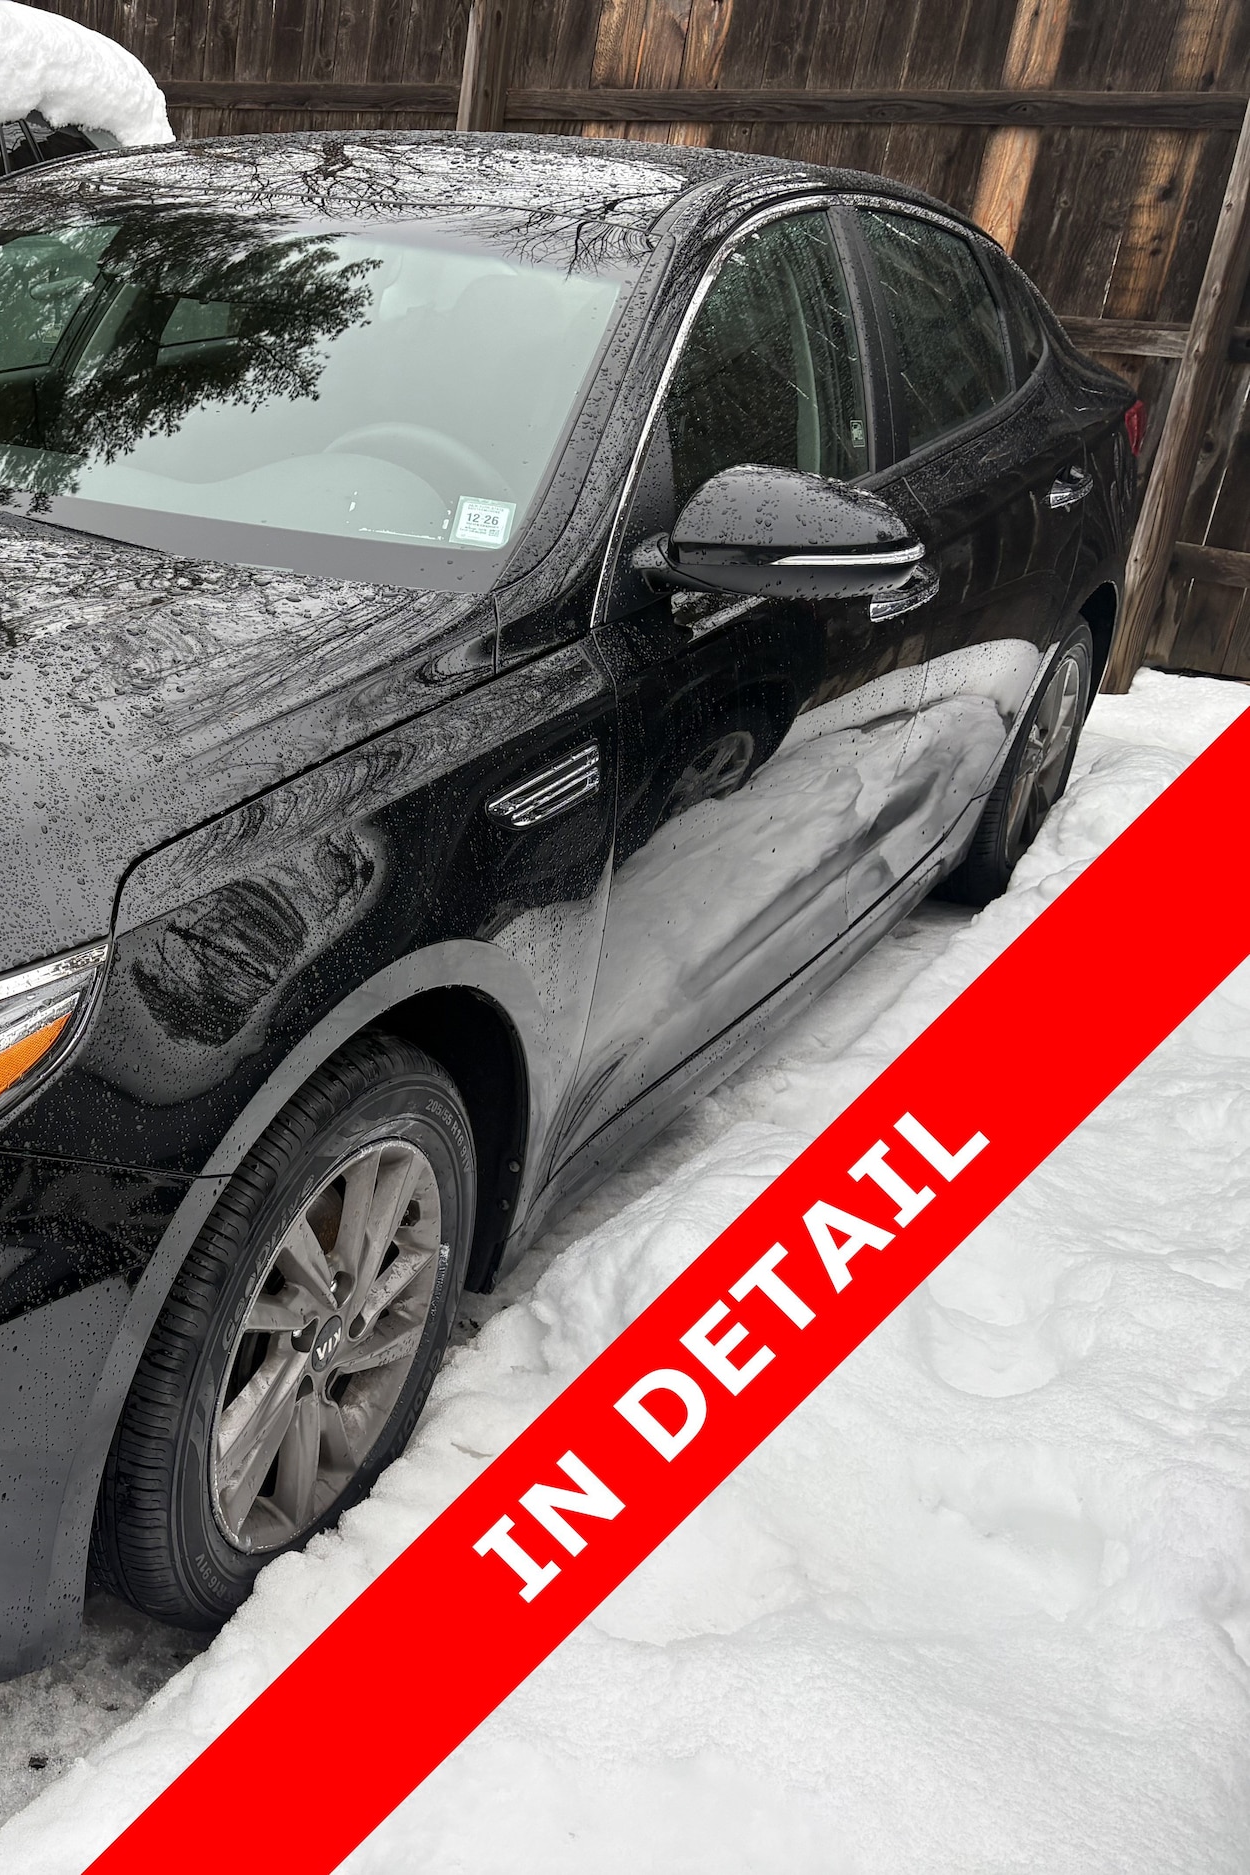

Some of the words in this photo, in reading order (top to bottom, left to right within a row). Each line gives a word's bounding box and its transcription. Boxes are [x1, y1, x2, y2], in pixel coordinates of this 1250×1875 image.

[483, 514, 500, 526] 26
[425, 1099, 453, 1126] 205/55
[316, 1326, 342, 1361] KIA
[195, 1553, 212, 1580] 91V
[207, 1575, 227, 1598] R16
